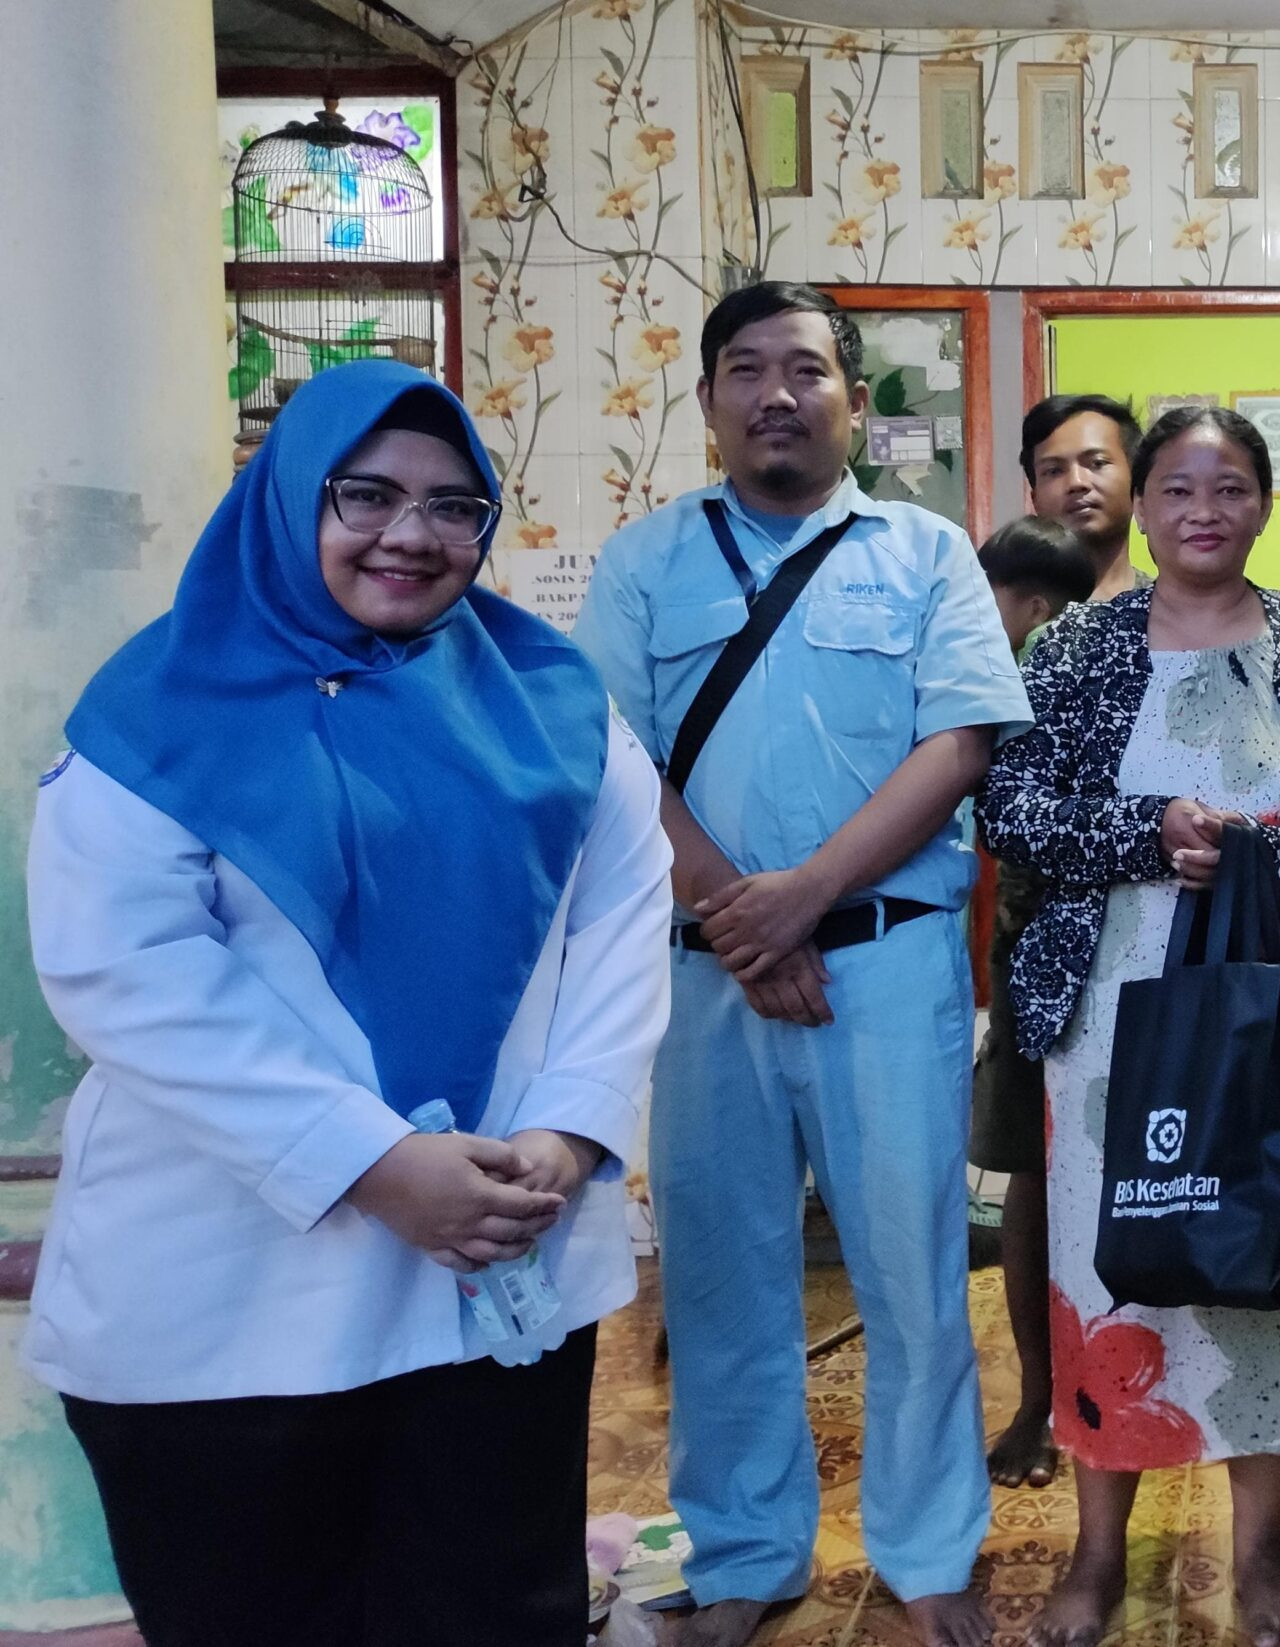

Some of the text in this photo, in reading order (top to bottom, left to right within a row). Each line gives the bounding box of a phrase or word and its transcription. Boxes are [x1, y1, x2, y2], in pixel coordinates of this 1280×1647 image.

[554, 555, 597, 569] JUA
[846, 583, 885, 595] RIKEN
[1114, 1179, 1135, 1204] BS
[1192, 1200, 1220, 1211] Sosial
